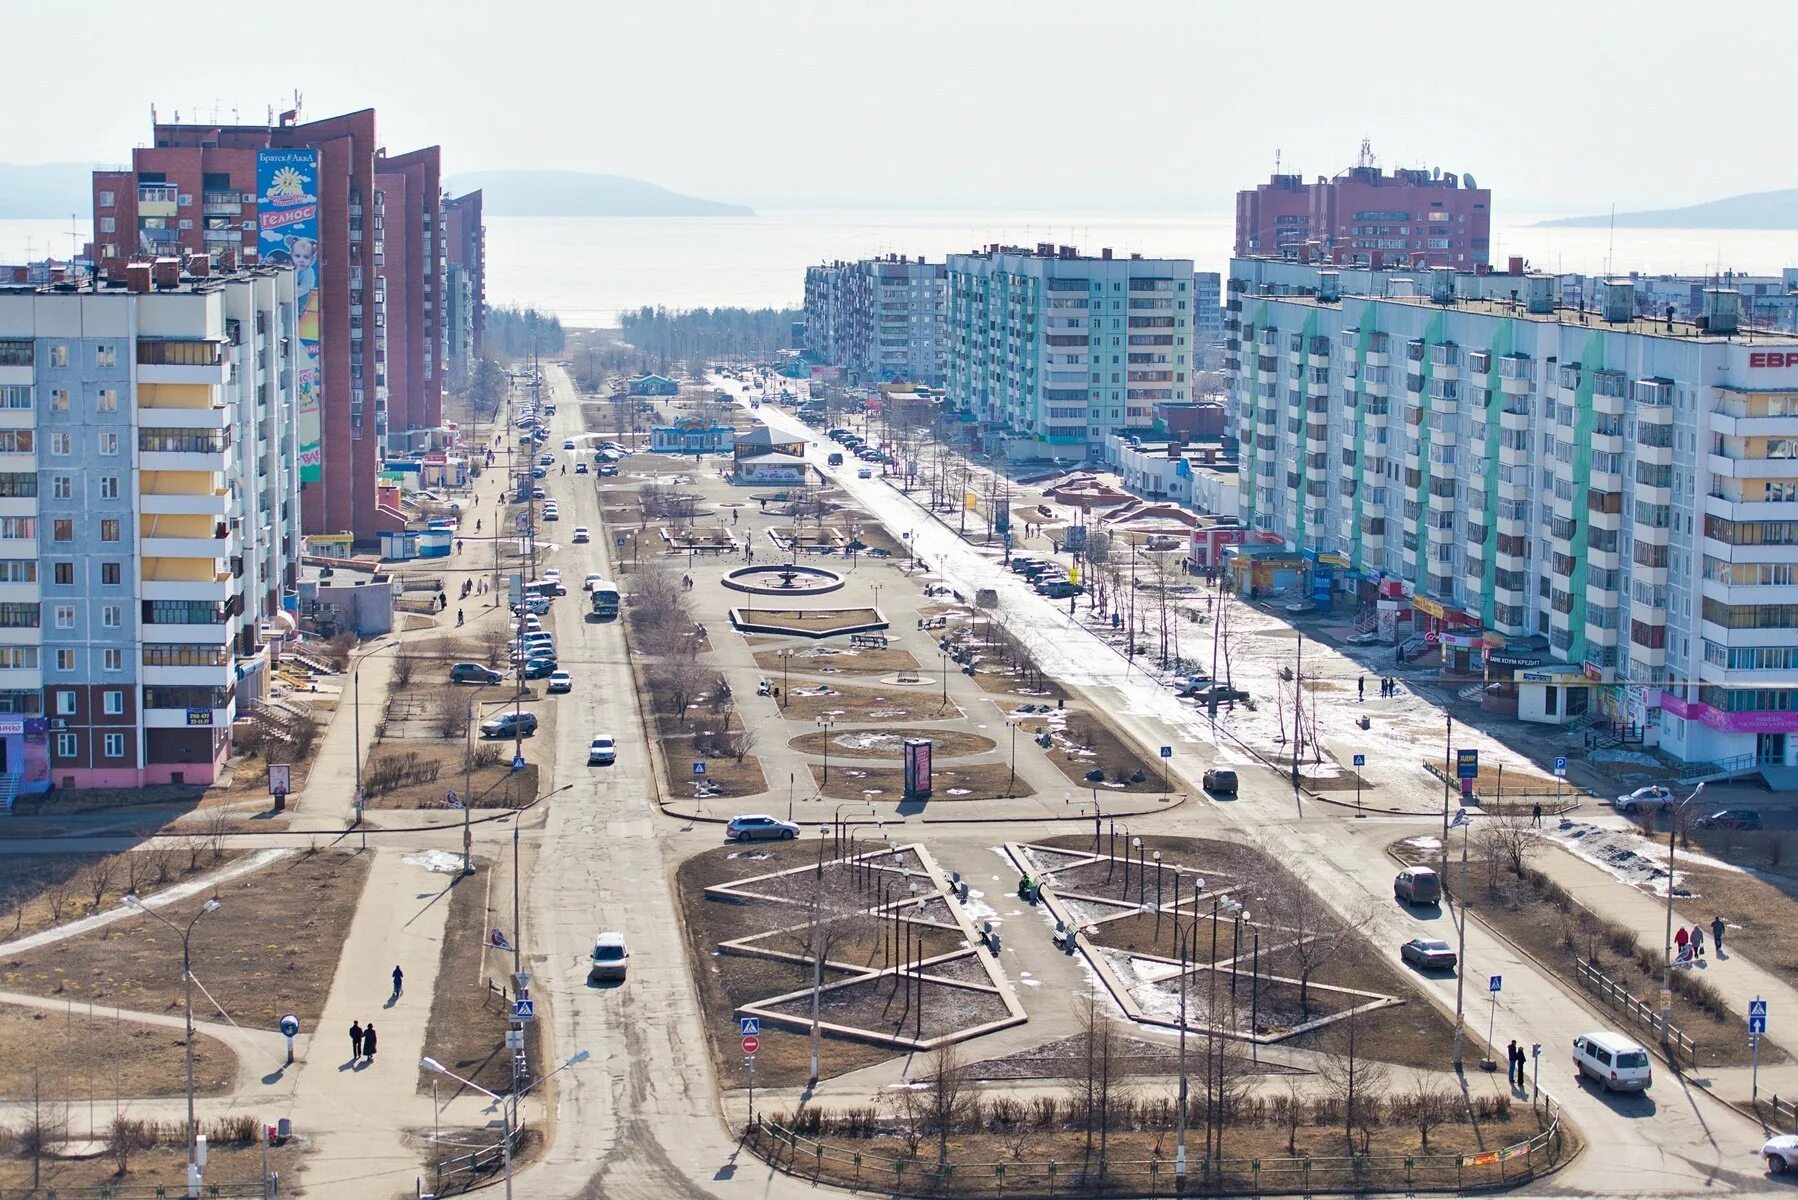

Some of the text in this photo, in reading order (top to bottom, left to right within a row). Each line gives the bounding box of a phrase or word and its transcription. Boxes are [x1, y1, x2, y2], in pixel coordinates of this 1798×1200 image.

[260, 154, 287, 164] Братск
[262, 207, 311, 226] Гелиос
[1517, 659, 1540, 667] КРЕДИТ
